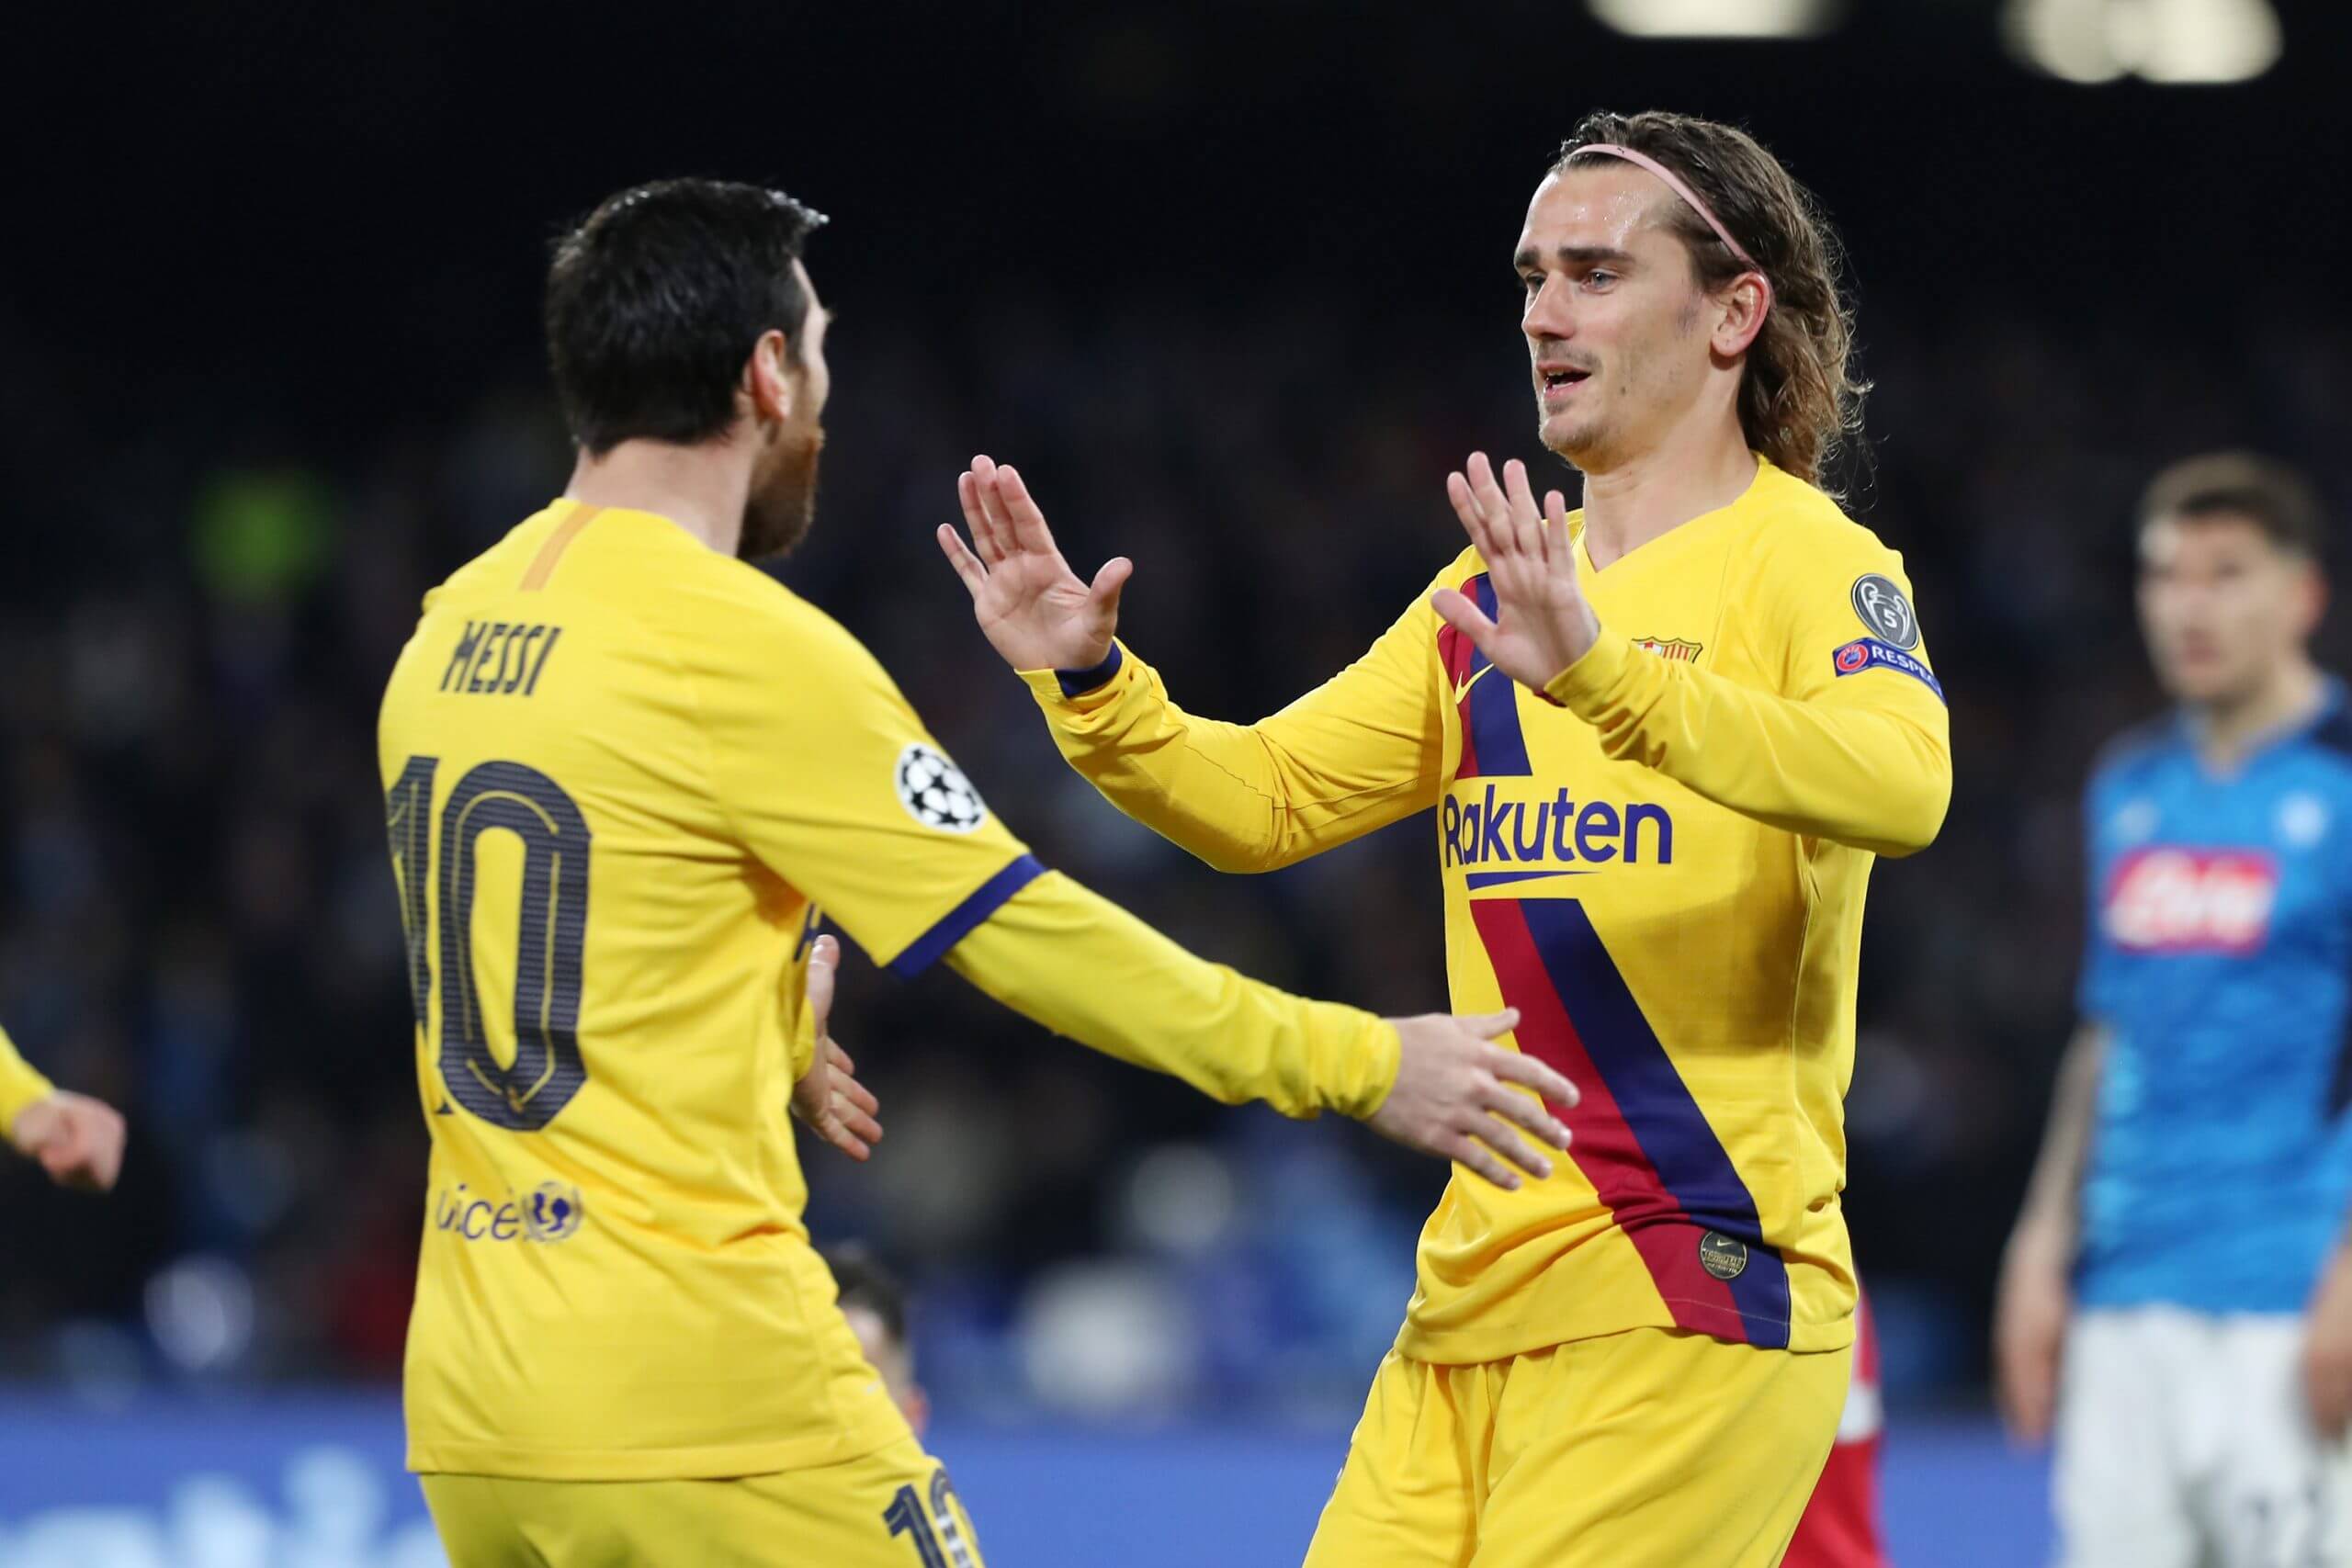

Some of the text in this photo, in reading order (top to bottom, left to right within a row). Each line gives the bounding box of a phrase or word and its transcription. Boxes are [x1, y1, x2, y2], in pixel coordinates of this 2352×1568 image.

[1883, 607, 1898, 628] 5
[439, 620, 563, 696] MESSI
[1871, 645, 1942, 699] RESPE
[1443, 784, 1673, 868] Rakuten
